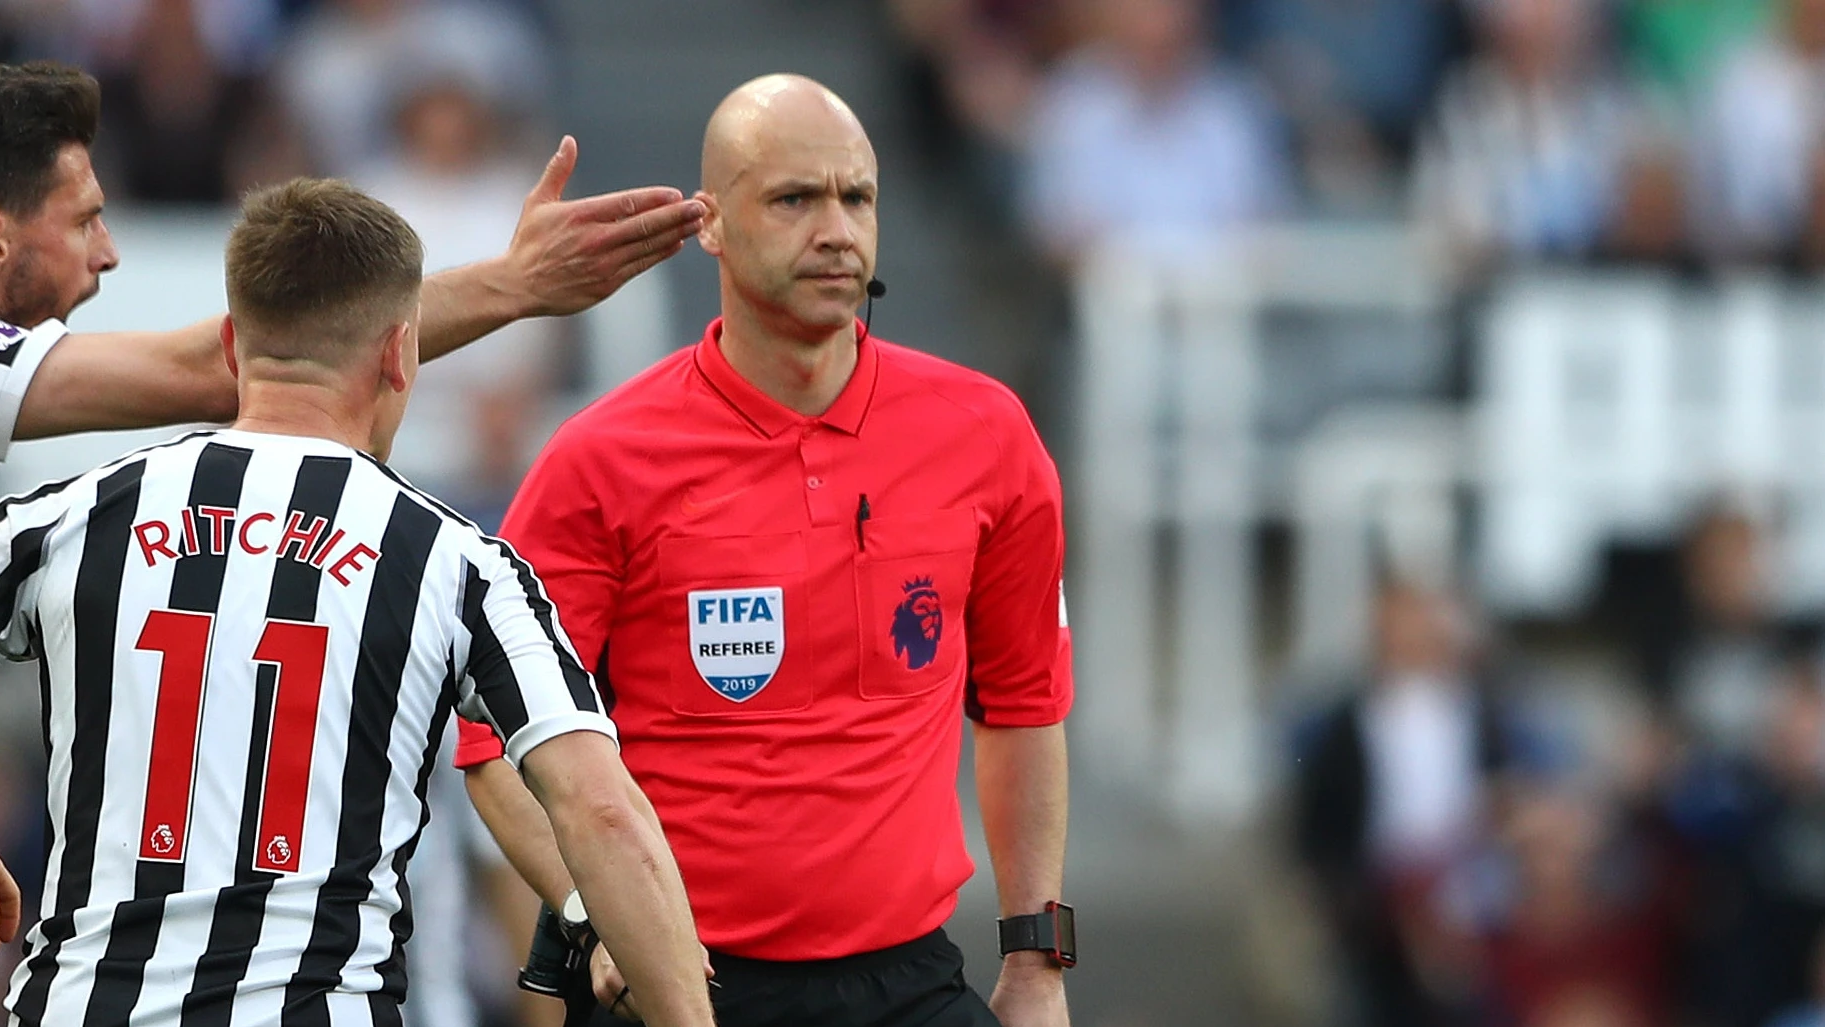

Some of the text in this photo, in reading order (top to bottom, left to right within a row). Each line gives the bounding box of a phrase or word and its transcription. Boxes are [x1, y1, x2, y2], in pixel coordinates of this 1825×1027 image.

[132, 504, 380, 588] RITCHIE
[697, 596, 774, 625] FIFA
[699, 641, 776, 657] REFEREE
[721, 678, 756, 692] 2019
[134, 608, 330, 873] 11
